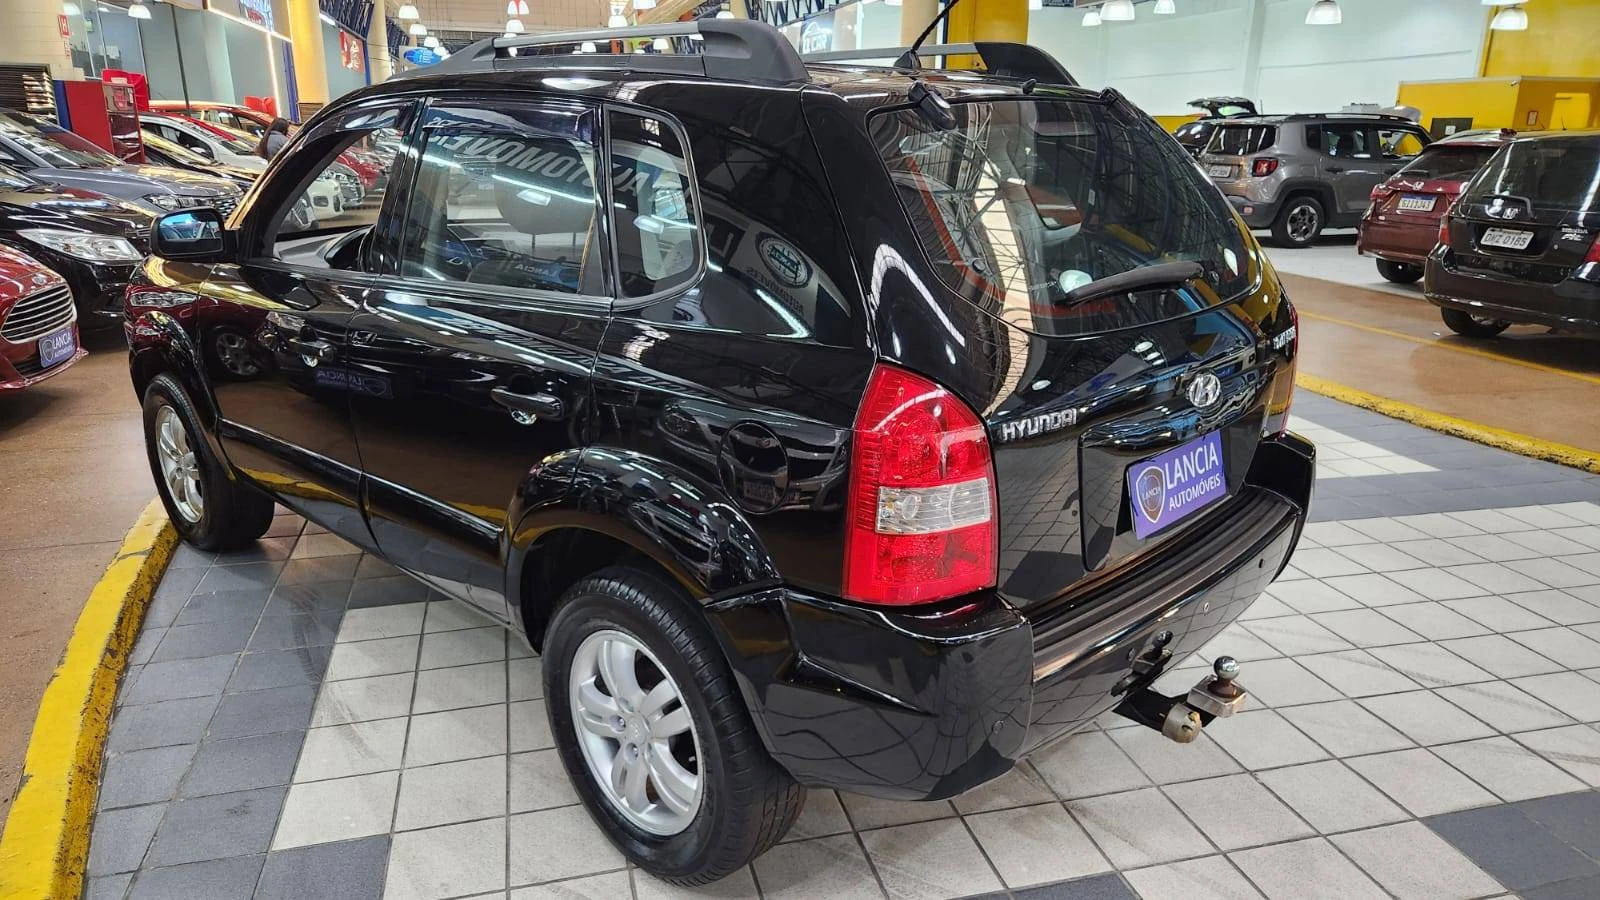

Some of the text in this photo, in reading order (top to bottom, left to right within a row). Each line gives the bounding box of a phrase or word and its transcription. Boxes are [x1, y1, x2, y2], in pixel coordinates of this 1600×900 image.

[1002, 408, 1077, 441] HYUNDAI
[1165, 442, 1219, 490] LANCIA
[1168, 473, 1221, 512] AUTOMÓVEIS
